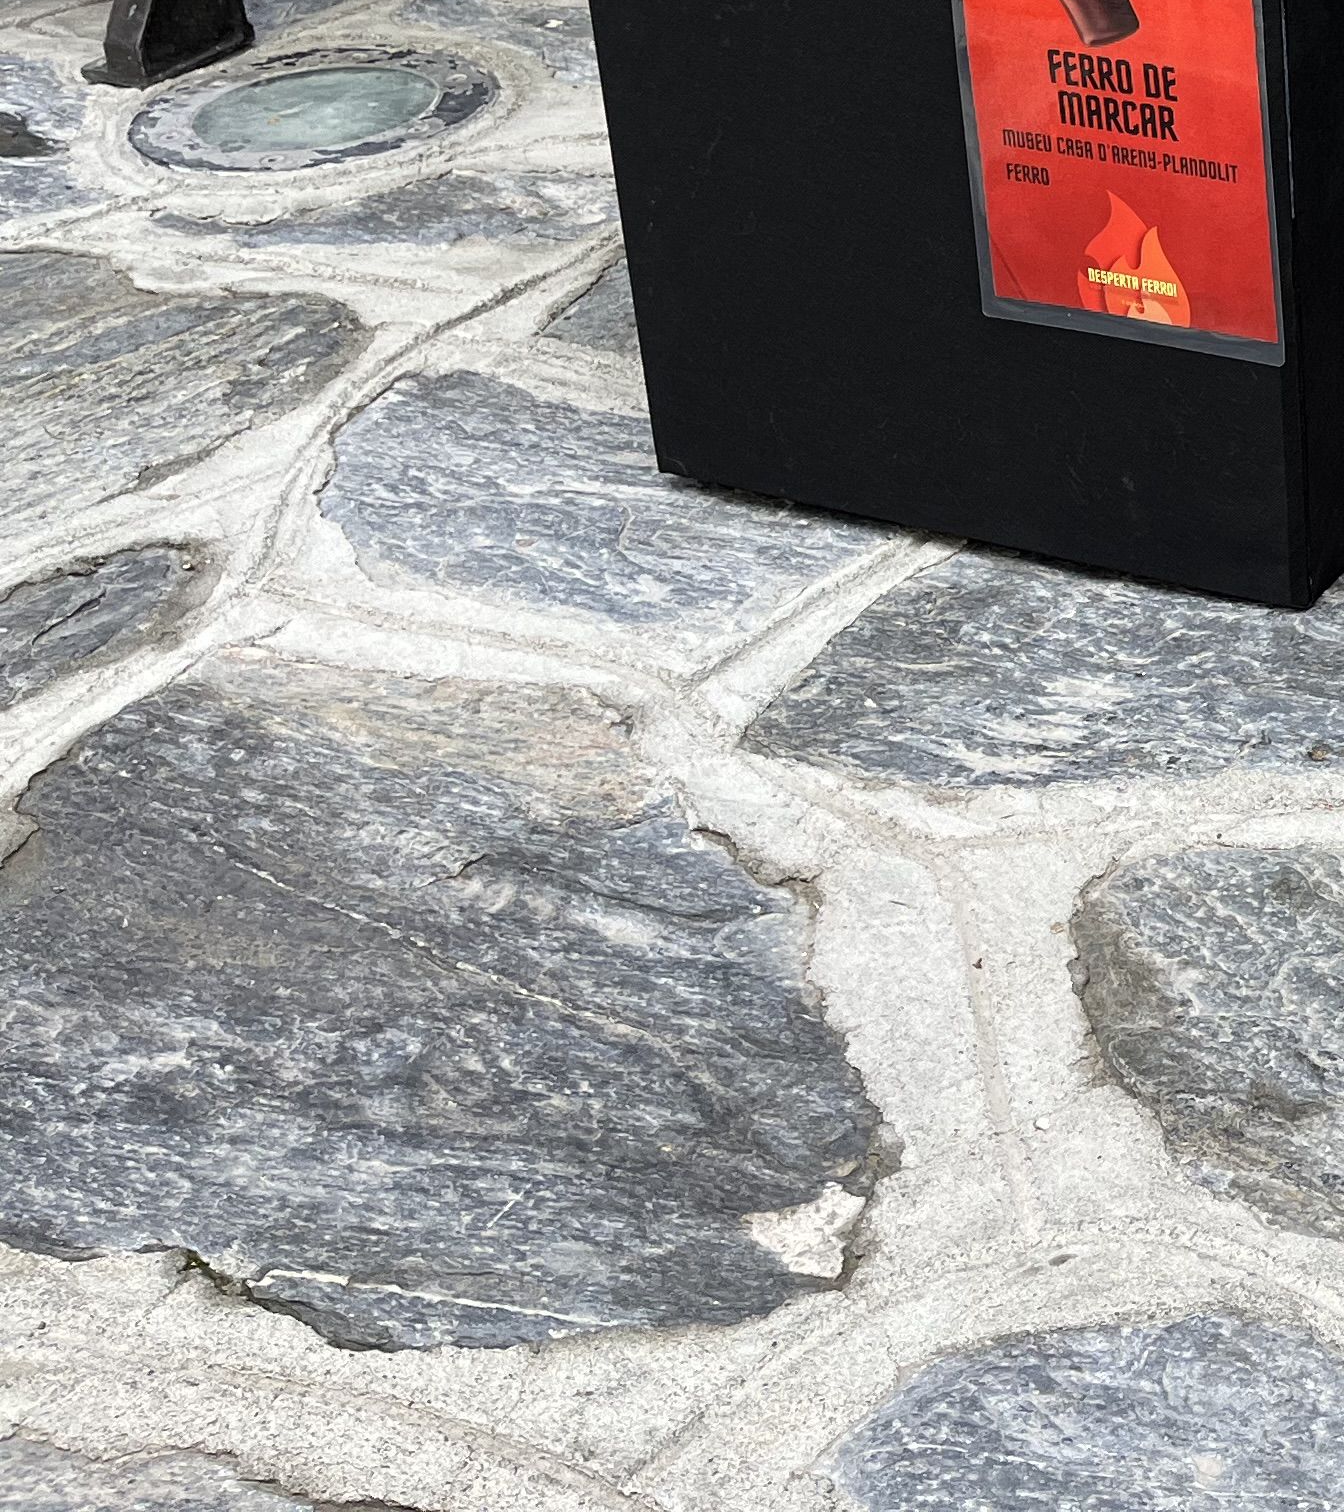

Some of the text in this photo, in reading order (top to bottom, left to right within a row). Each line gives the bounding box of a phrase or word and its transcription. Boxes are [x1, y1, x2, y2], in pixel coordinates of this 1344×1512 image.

[1047, 49, 1178, 102] FERRO DE
[1058, 90, 1179, 141] MARCAR
[1003, 129, 1237, 183] MUSEU CASA D'ARENY-PLANDOLIT
[1006, 163, 1049, 186] FERRO
[1088, 267, 1139, 290] DESPERTA
